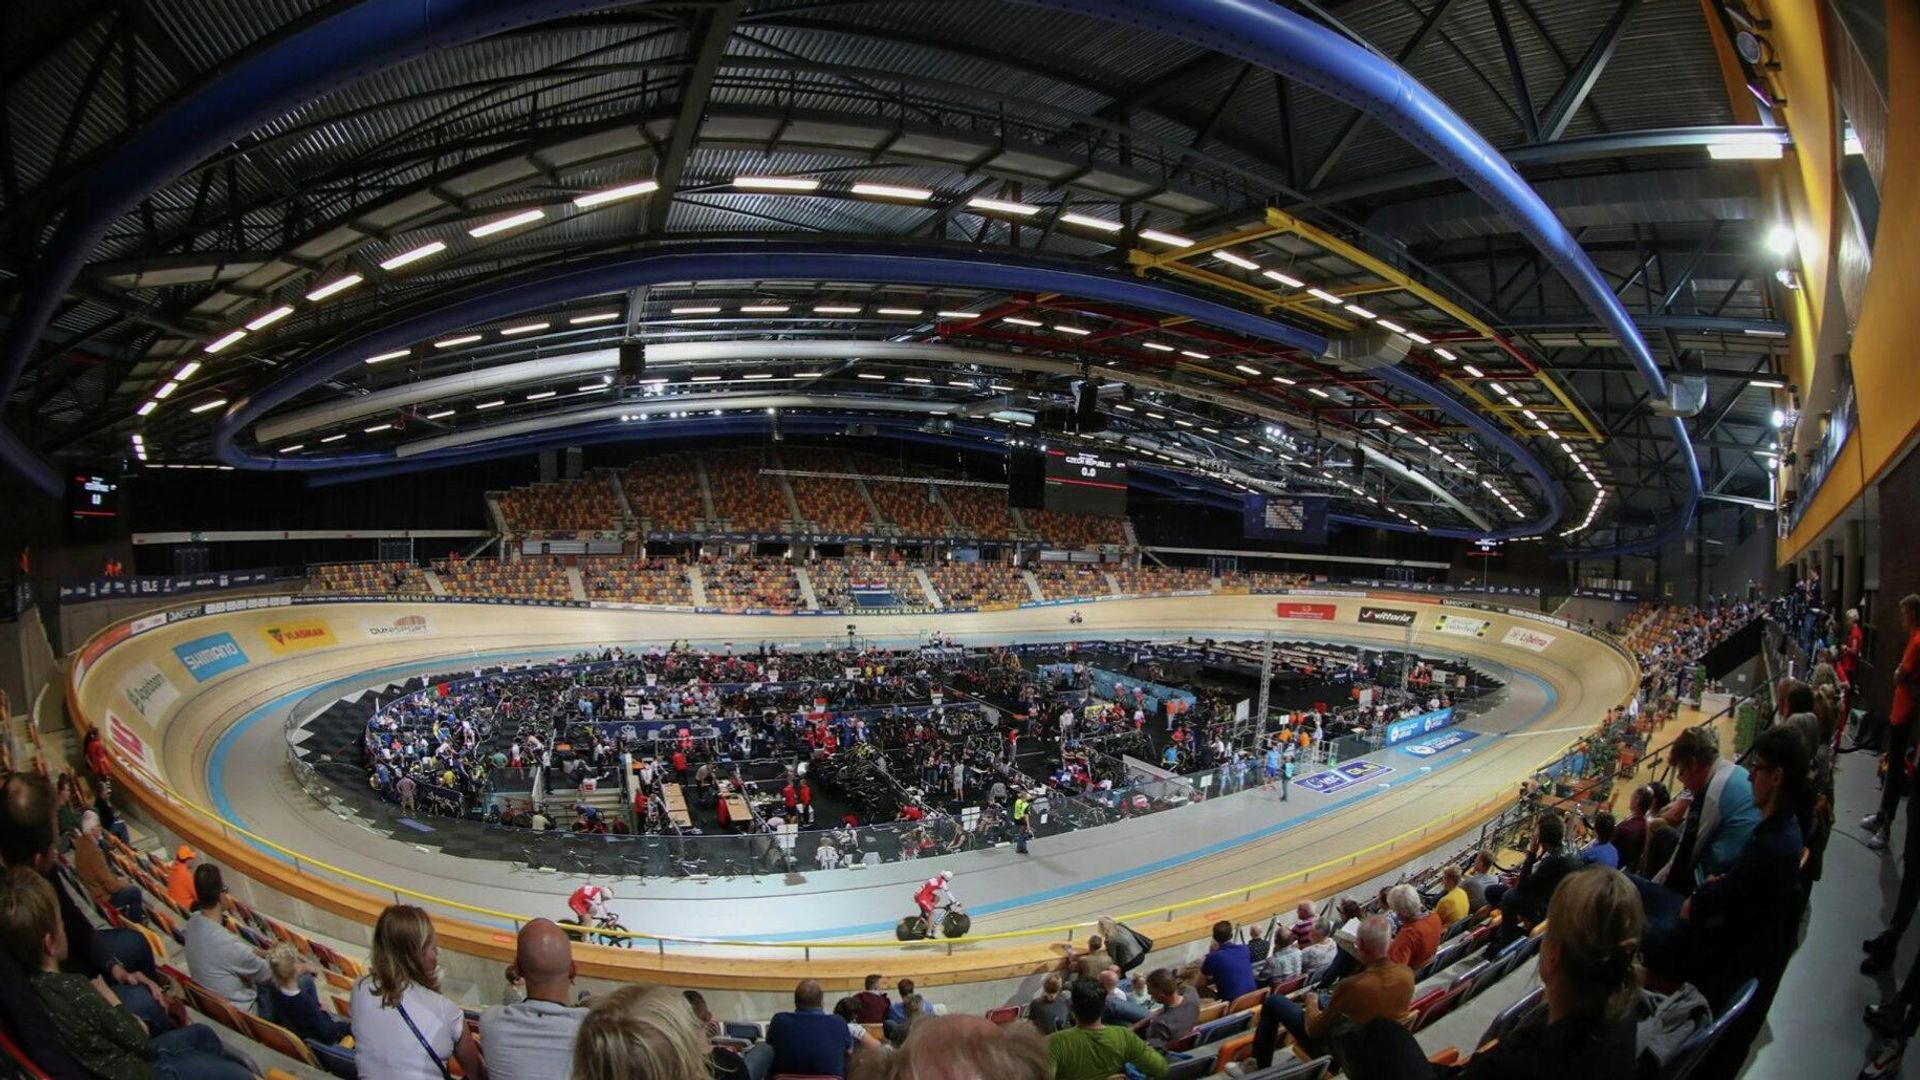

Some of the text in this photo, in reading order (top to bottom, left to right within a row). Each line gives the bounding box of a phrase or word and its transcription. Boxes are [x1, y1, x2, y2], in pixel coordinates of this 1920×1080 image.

[1085, 457, 1112, 469] REPUBLIC
[1081, 466, 1096, 477] 0.0
[1374, 611, 1412, 622] vittoria
[286, 628, 326, 640] VLASMAN
[183, 642, 238, 670] SHIMANO
